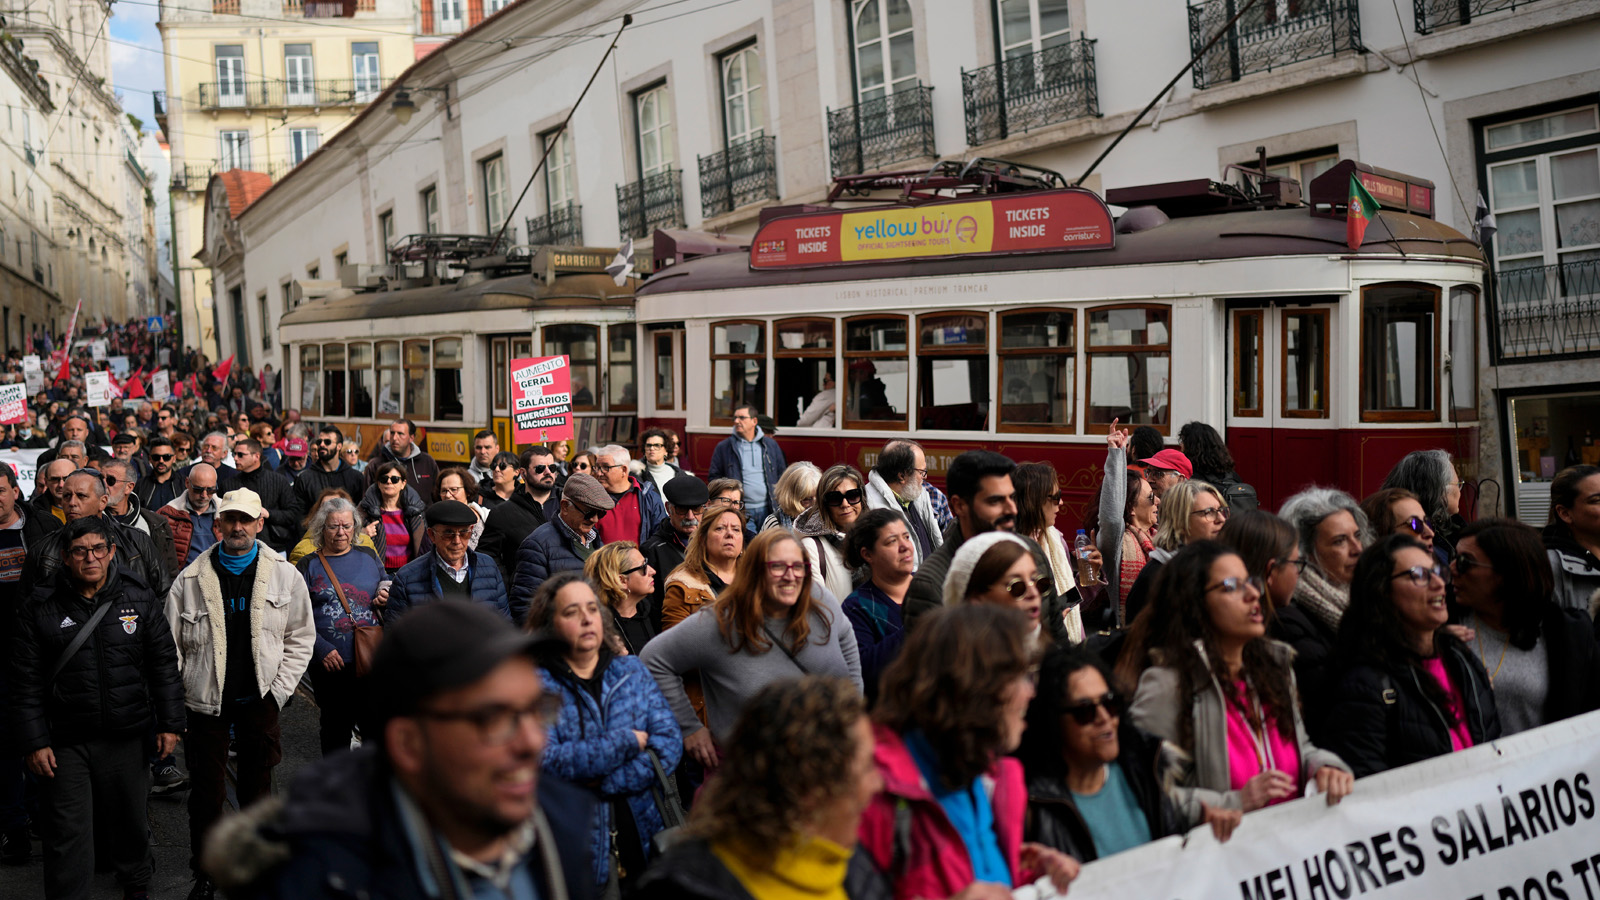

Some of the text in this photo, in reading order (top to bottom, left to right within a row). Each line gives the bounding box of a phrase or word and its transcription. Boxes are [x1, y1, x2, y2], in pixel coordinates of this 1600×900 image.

[1005, 207, 1050, 222] TICKETS
[795, 226, 831, 239] TICKETS
[854, 215, 953, 240] yellow bus
[1009, 224, 1046, 239] INSIDE
[798, 241, 828, 254] INSIDE
[857, 237, 951, 251] OFFICIAL SIGHTSEEING TOURS
[554, 254, 600, 267] CARREIRA
[835, 283, 988, 300] LISBON HISTORICAL PREMIUM TRAMCAR
[515, 358, 564, 380] AUMENTO
[521, 376, 552, 388] GERAL
[526, 389, 542, 397] DOS
[518, 394, 569, 408] SALÁRIOS
[516, 405, 569, 421] EMERGÊNCIA
[520, 417, 565, 429] NACIONAL!
[431, 439, 452, 453] carris
[1431, 772, 1595, 866] SALÁRIOS
